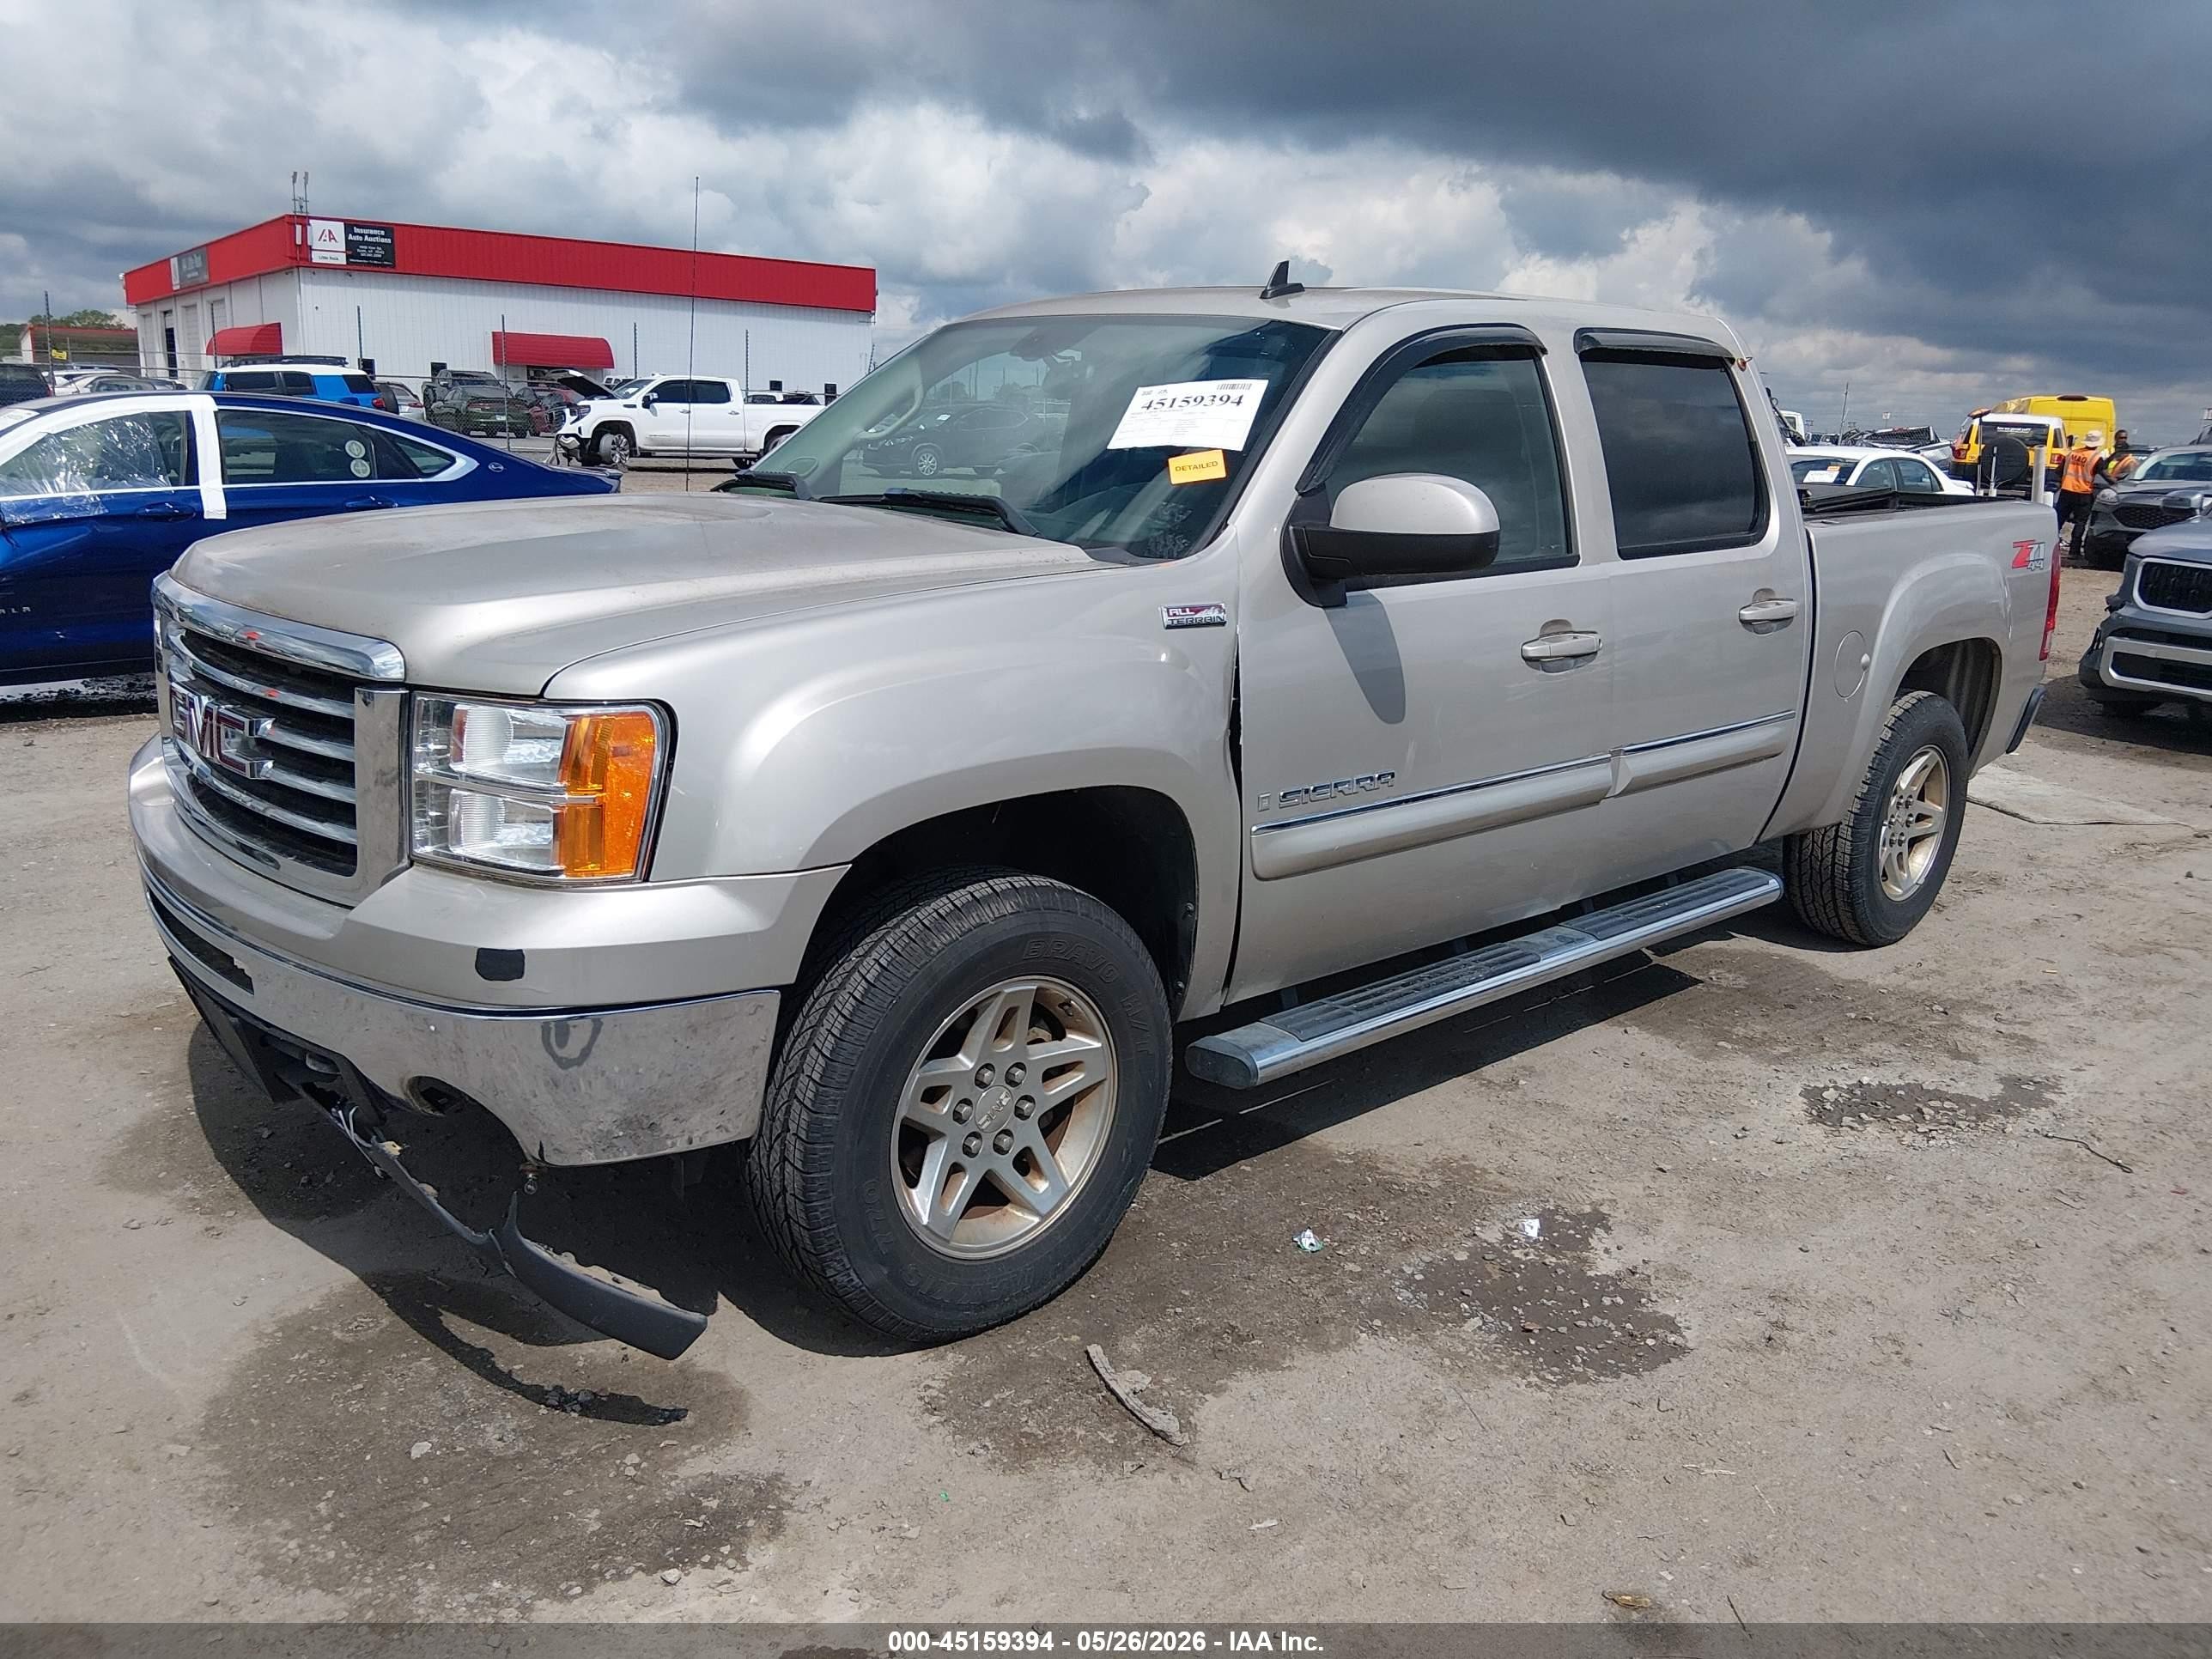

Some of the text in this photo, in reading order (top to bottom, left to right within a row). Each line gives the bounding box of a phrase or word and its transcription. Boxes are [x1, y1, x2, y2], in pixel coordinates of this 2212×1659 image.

[354, 226, 385, 235] Insurance
[364, 235, 392, 244] Auctions
[1140, 393, 1244, 411] 45159394
[1175, 460, 1218, 472] DETAILED
[1169, 607, 1195, 617] ALL
[1168, 616, 1224, 625] TERRAIN
[171, 682, 276, 780] GMC
[1279, 770, 1395, 809] SIERRA
[1023, 939, 1119, 984] BRAVO
[978, 1091, 1012, 1129] GMC
